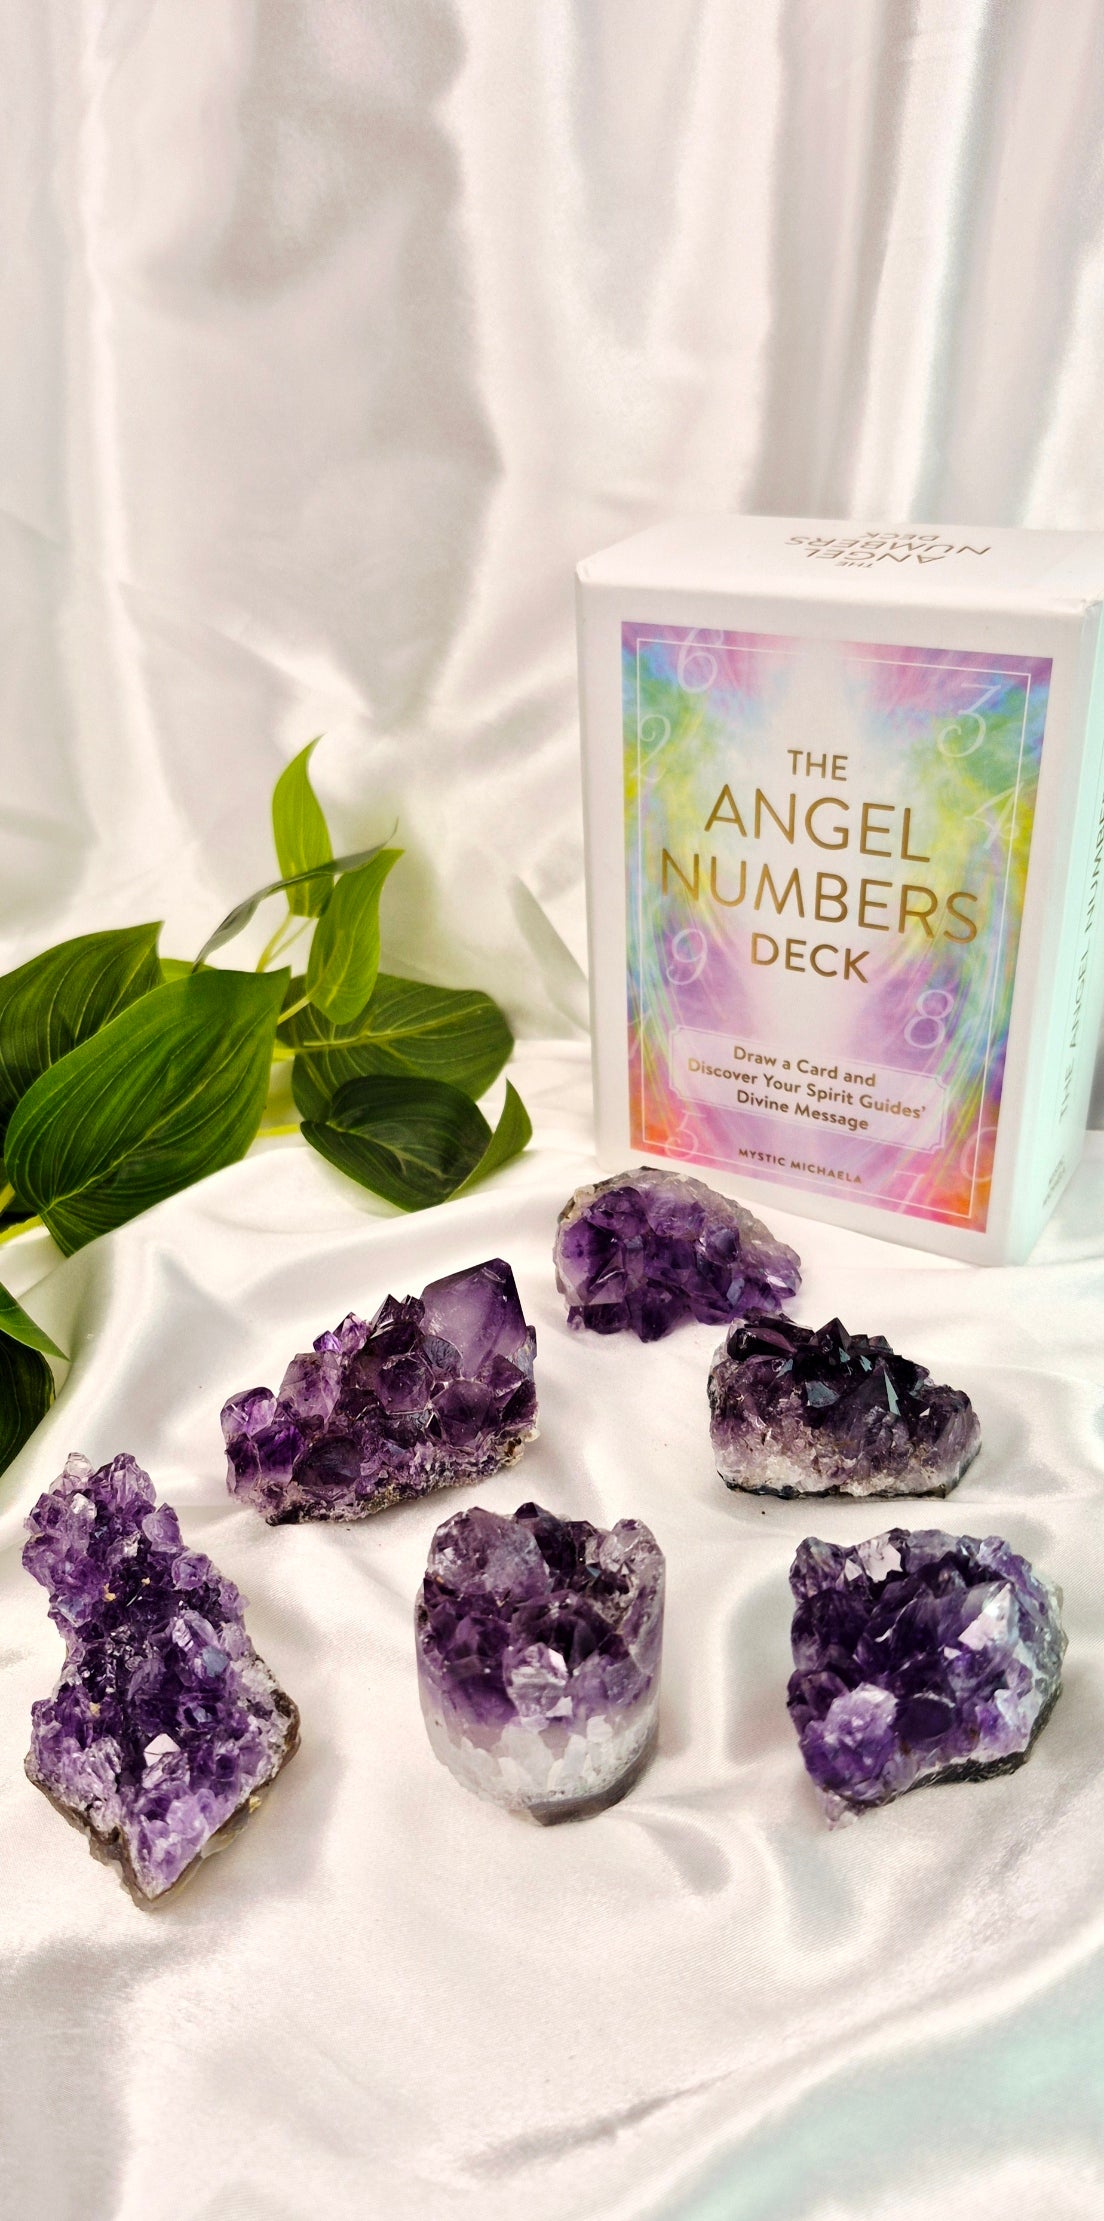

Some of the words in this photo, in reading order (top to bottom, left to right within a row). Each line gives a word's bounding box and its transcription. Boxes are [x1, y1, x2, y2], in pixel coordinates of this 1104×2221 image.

[784, 535, 992, 556] NUMBERS
[805, 547, 945, 565] ANGEL
[858, 531, 941, 542] DECK
[834, 560, 874, 569] THE
[937, 681, 1002, 758] 3
[630, 713, 671, 783] 2
[786, 748, 848, 782] THE
[703, 783, 931, 863] ANGEL
[660, 847, 979, 945] NUMBERS
[666, 927, 708, 986] 9
[750, 931, 871, 984] DECK
[903, 989, 955, 1050] 8
[687, 1057, 758, 1085] Discover
[763, 1073, 802, 1095] Your
[806, 1082, 854, 1106] Spirit
[733, 1045, 777, 1067] Draw
[782, 1060, 792, 1071] a
[796, 1059, 838, 1080] Card
[843, 1071, 876, 1088] and
[663, 1109, 708, 1160] 5
[736, 1089, 790, 1113] Divine
[794, 1101, 870, 1132] Message
[738, 1148, 787, 1167] MYSTIC
[790, 1159, 863, 1185] MICHAELA
